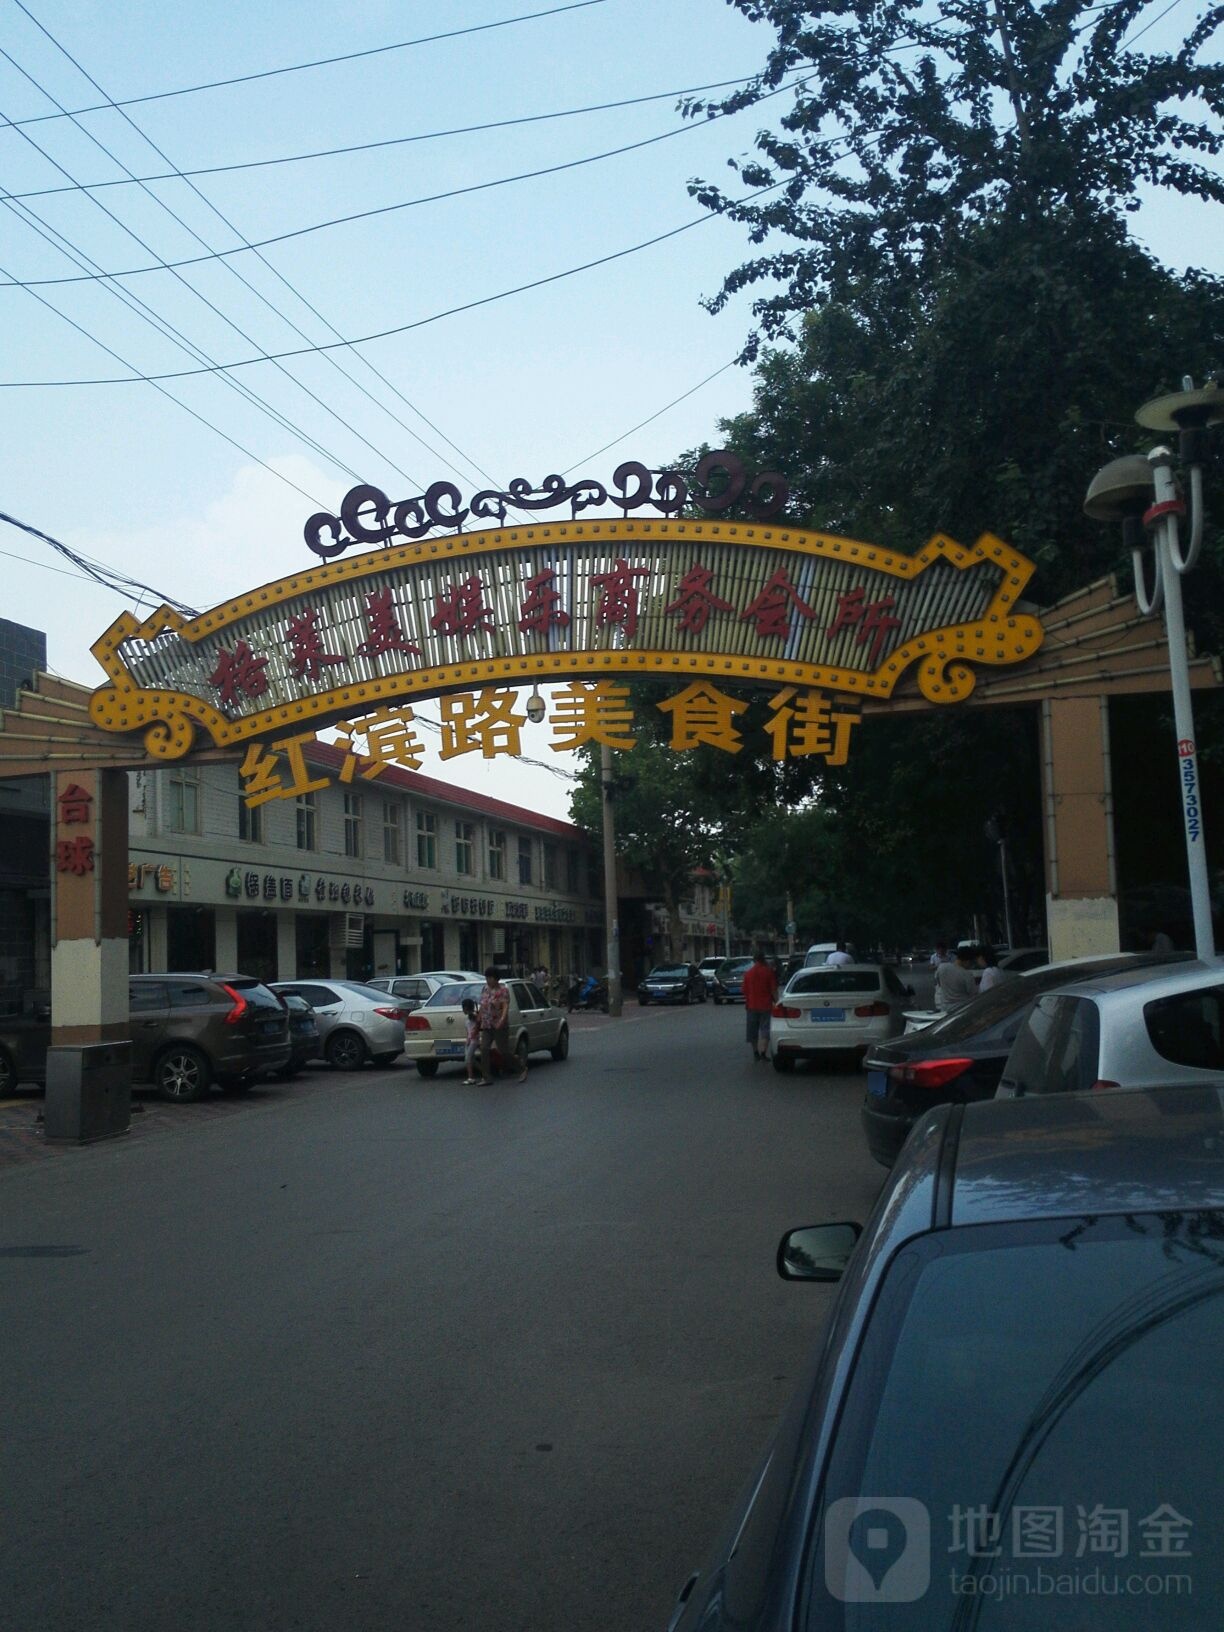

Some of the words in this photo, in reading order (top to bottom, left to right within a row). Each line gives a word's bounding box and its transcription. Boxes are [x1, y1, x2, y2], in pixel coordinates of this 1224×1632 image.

[239, 679, 862, 809] 红滨路美食街
[58, 784, 94, 876] 台球
[1183, 759, 1200, 842] 3573027
